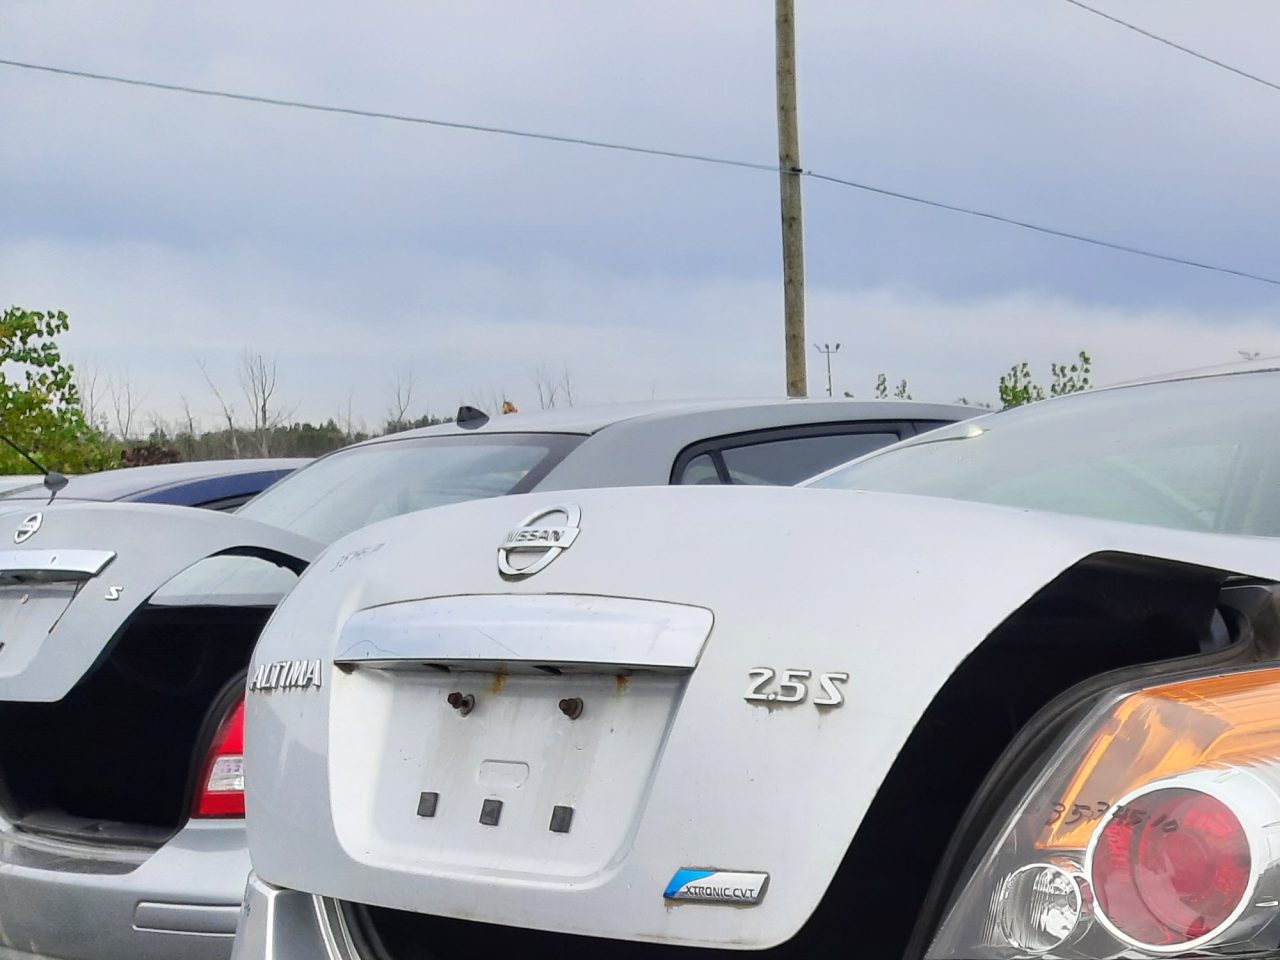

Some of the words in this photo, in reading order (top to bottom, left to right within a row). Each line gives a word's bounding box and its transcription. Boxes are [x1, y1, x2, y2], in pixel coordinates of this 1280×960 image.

[504, 529, 566, 543] NISSAN
[104, 585, 124, 601] S
[249, 658, 322, 691] ALTIMA
[743, 666, 812, 704] 2.5
[812, 672, 850, 707] S
[685, 885, 730, 898] XTRONIC
[732, 887, 755, 899] CVT
